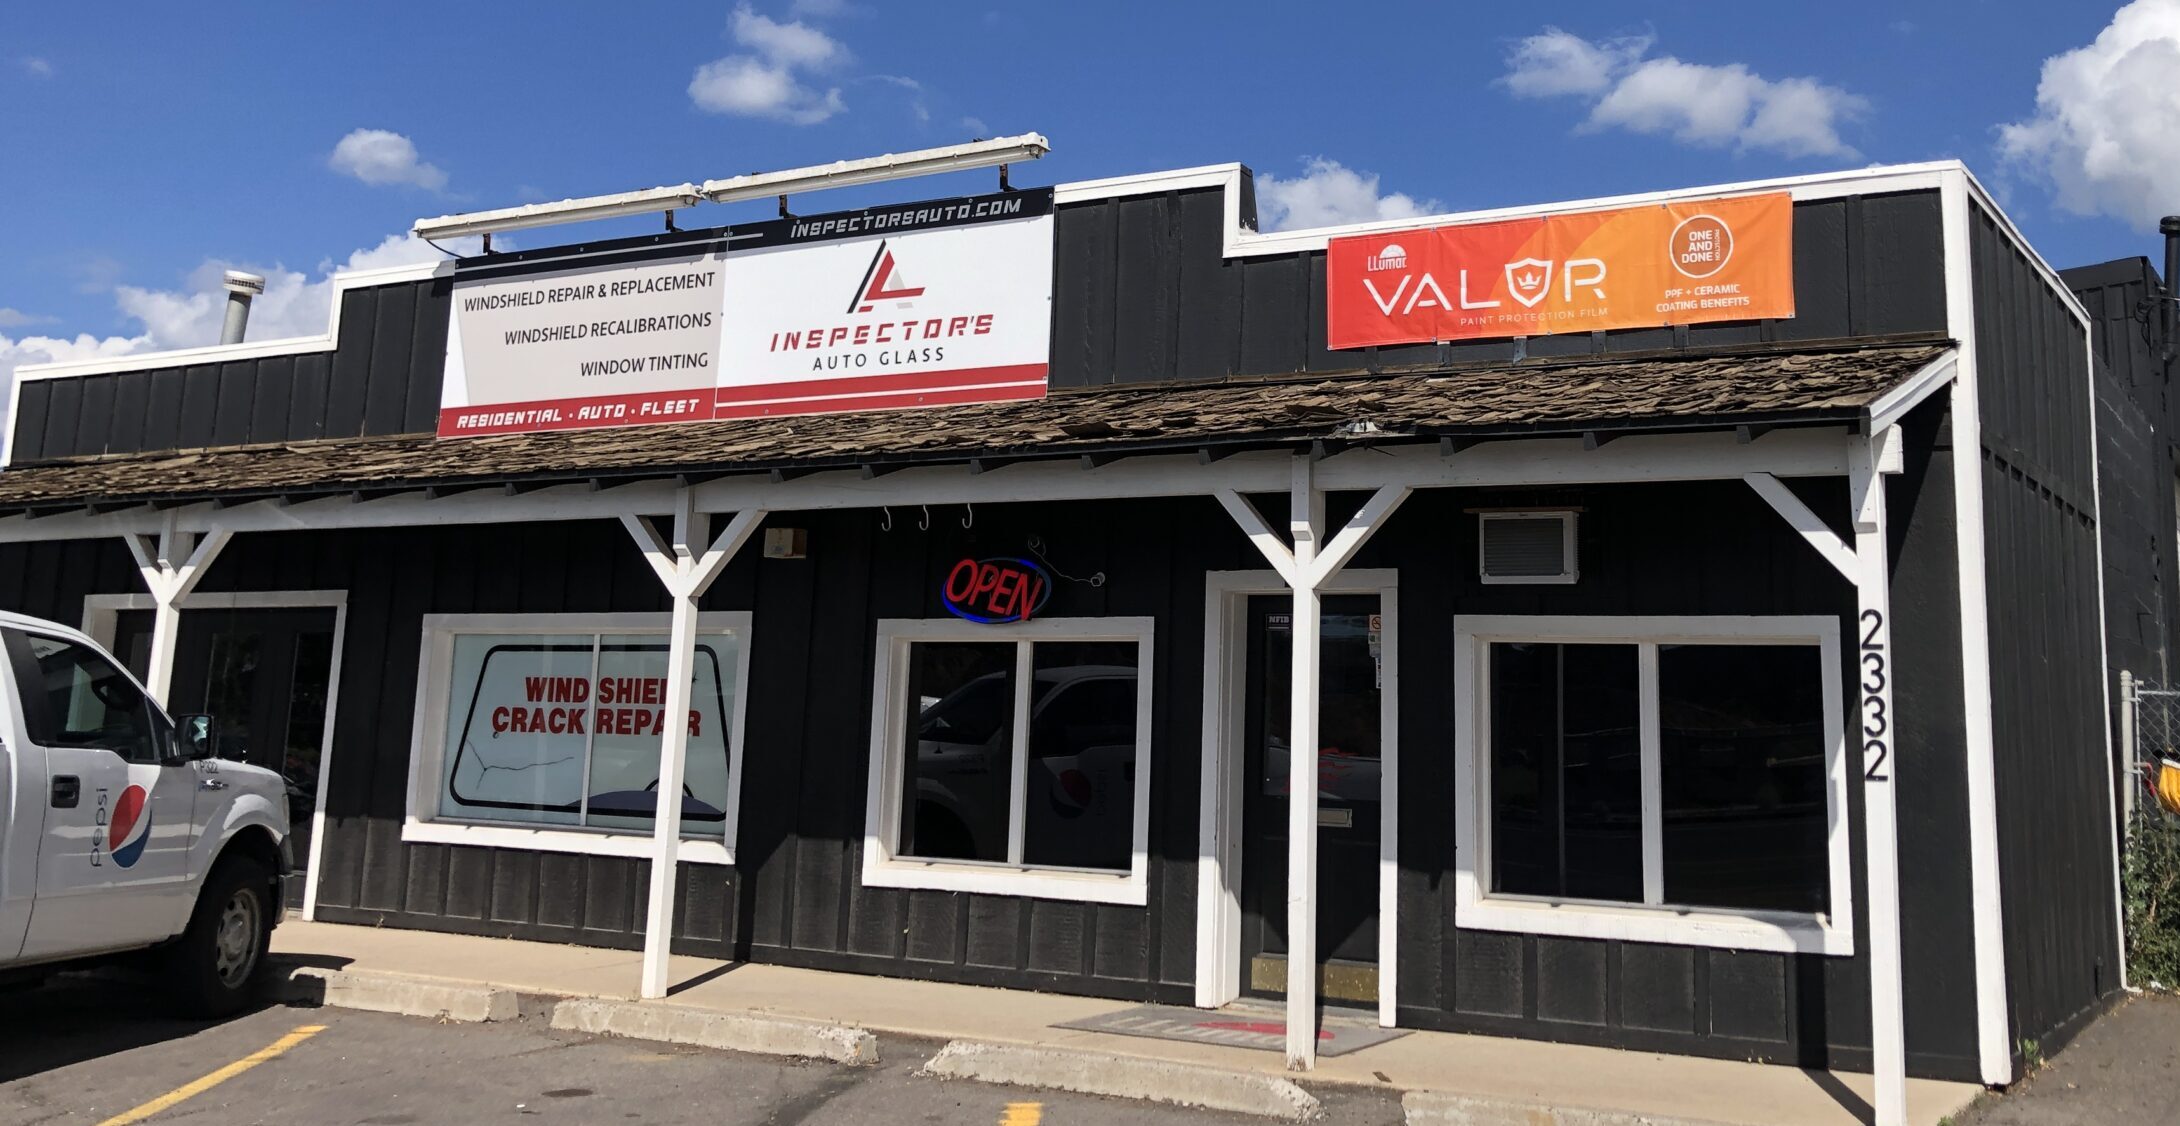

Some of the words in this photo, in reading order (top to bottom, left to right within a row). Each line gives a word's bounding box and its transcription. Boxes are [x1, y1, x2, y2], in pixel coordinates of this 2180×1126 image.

[790, 198, 1022, 239] INSPECTORSAUTO.COM
[1688, 230, 1713, 241] ONE
[1688, 241, 1713, 252] AND
[1681, 251, 1713, 264] DONE
[464, 290, 545, 312] WINDSHIELD
[548, 284, 595, 304] REPAIR
[598, 282, 607, 298] &
[610, 271, 715, 297] REPLACEMENT
[1656, 299, 1698, 313] COATING
[1700, 296, 1750, 309] BENEFITS
[1665, 288, 1683, 299] PPF
[1694, 284, 1741, 296] CERAMIC
[505, 323, 587, 345] WINDSHIELD
[590, 311, 712, 337] RECALIBRATIONS
[1460, 314, 1494, 326] PAINT
[1499, 310, 1575, 324] PROTECTION
[1579, 307, 1609, 318] FILM
[770, 314, 994, 352] INSPECTOR'S
[580, 357, 646, 377] WINDOW
[648, 352, 709, 372] TINTING
[812, 353, 868, 371] AUTO
[880, 346, 945, 365] GLASS
[456, 408, 562, 429] RESIDENTIAL
[577, 403, 627, 421] AUTO
[640, 398, 700, 416] FLEET
[945, 558, 1044, 621] OPEN
[525, 676, 590, 703] WIND
[598, 677, 668, 704] SHIEL
[1860, 608, 1888, 782] 2332
[491, 706, 588, 735] CRACK
[596, 708, 702, 737] REPAR
[90, 788, 108, 867] pepsi
